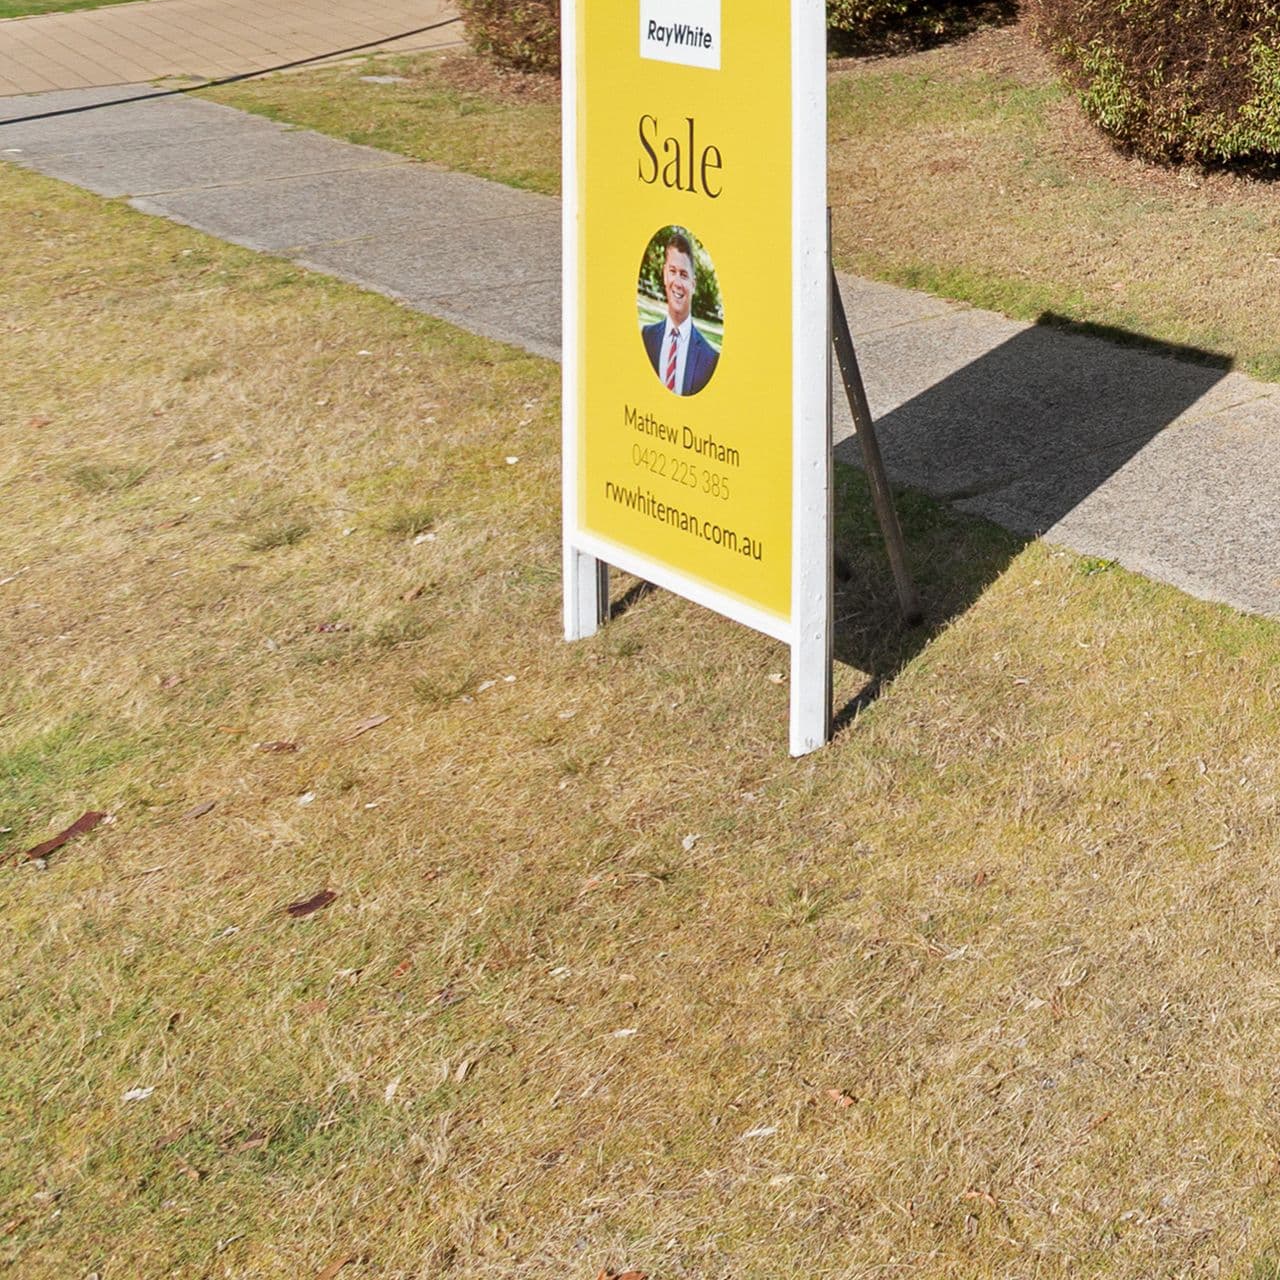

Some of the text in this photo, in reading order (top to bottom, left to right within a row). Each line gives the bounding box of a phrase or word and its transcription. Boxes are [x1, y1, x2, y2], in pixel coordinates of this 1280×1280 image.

[647, 19, 713, 49] RayWhite
[638, 114, 724, 199] Sale
[624, 404, 740, 468] Mathew Durham
[632, 443, 730, 501] 0422 225 385
[605, 480, 763, 561] rwwhiteman.com.au
